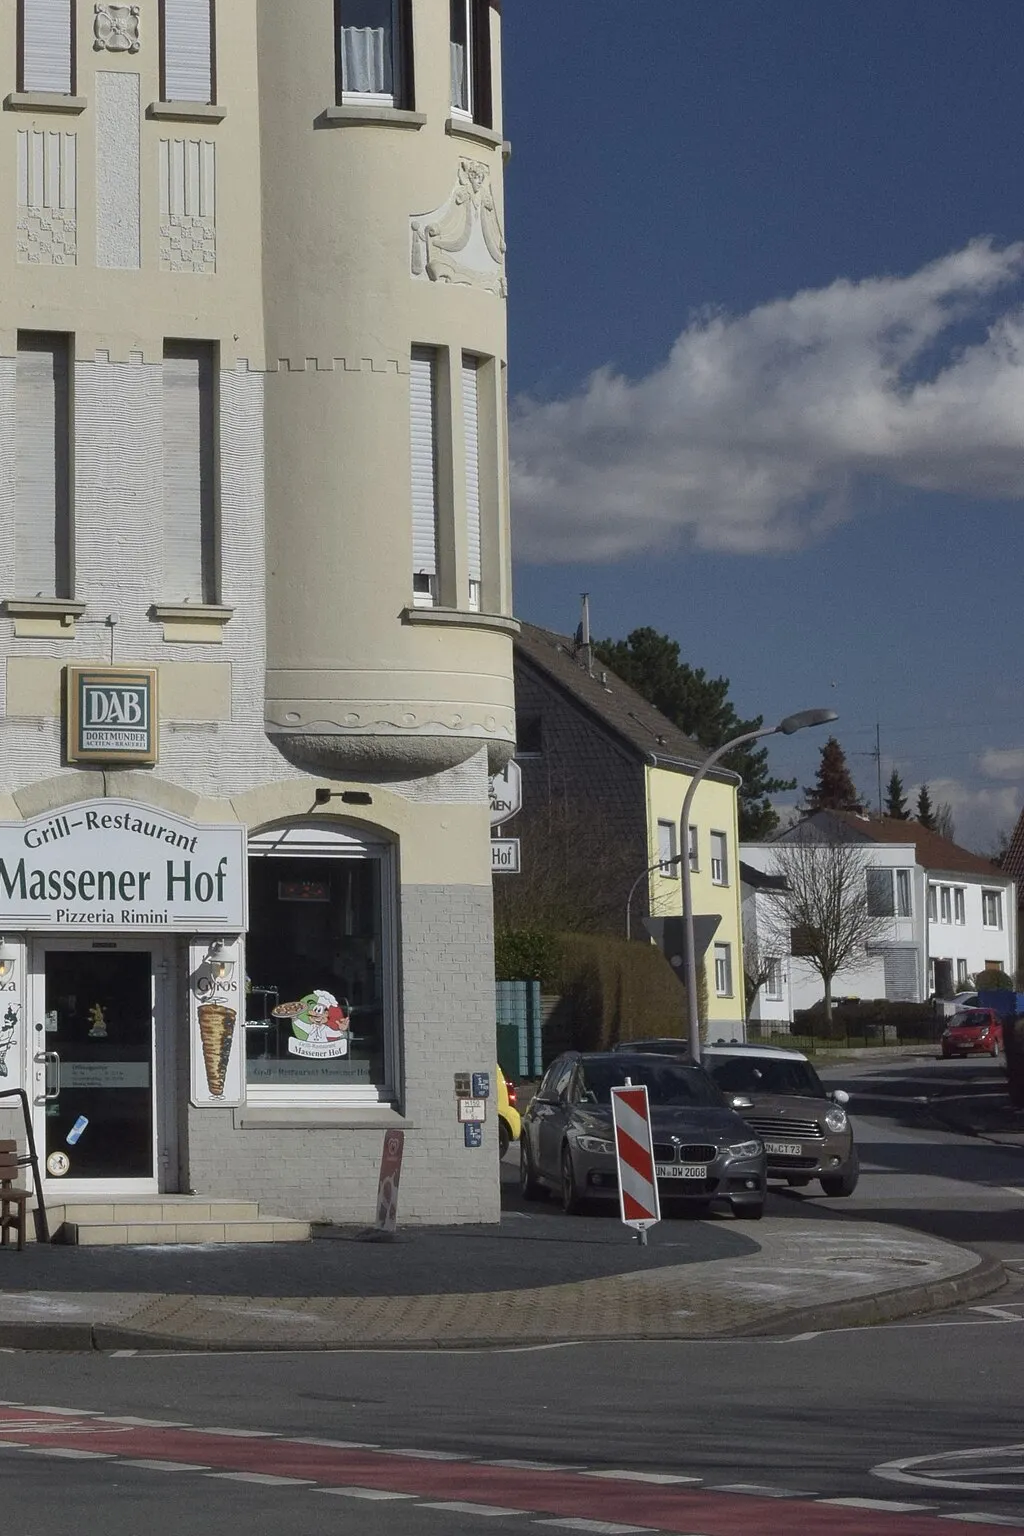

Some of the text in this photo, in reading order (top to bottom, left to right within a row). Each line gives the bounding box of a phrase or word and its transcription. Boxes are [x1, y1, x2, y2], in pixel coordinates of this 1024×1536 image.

[89, 691, 142, 723] DAB
[86, 732, 145, 741] DORTMUNDER
[23, 811, 199, 854] Grill-Restaurant
[492, 847, 512, 865] Hof
[166, 856, 228, 902] Hof
[56, 909, 168, 924] Pizzeria Rimini
[197, 977, 237, 995] Gyros
[293, 1045, 342, 1057] Massener Hof
[685, 1167, 706, 1177] 2008
